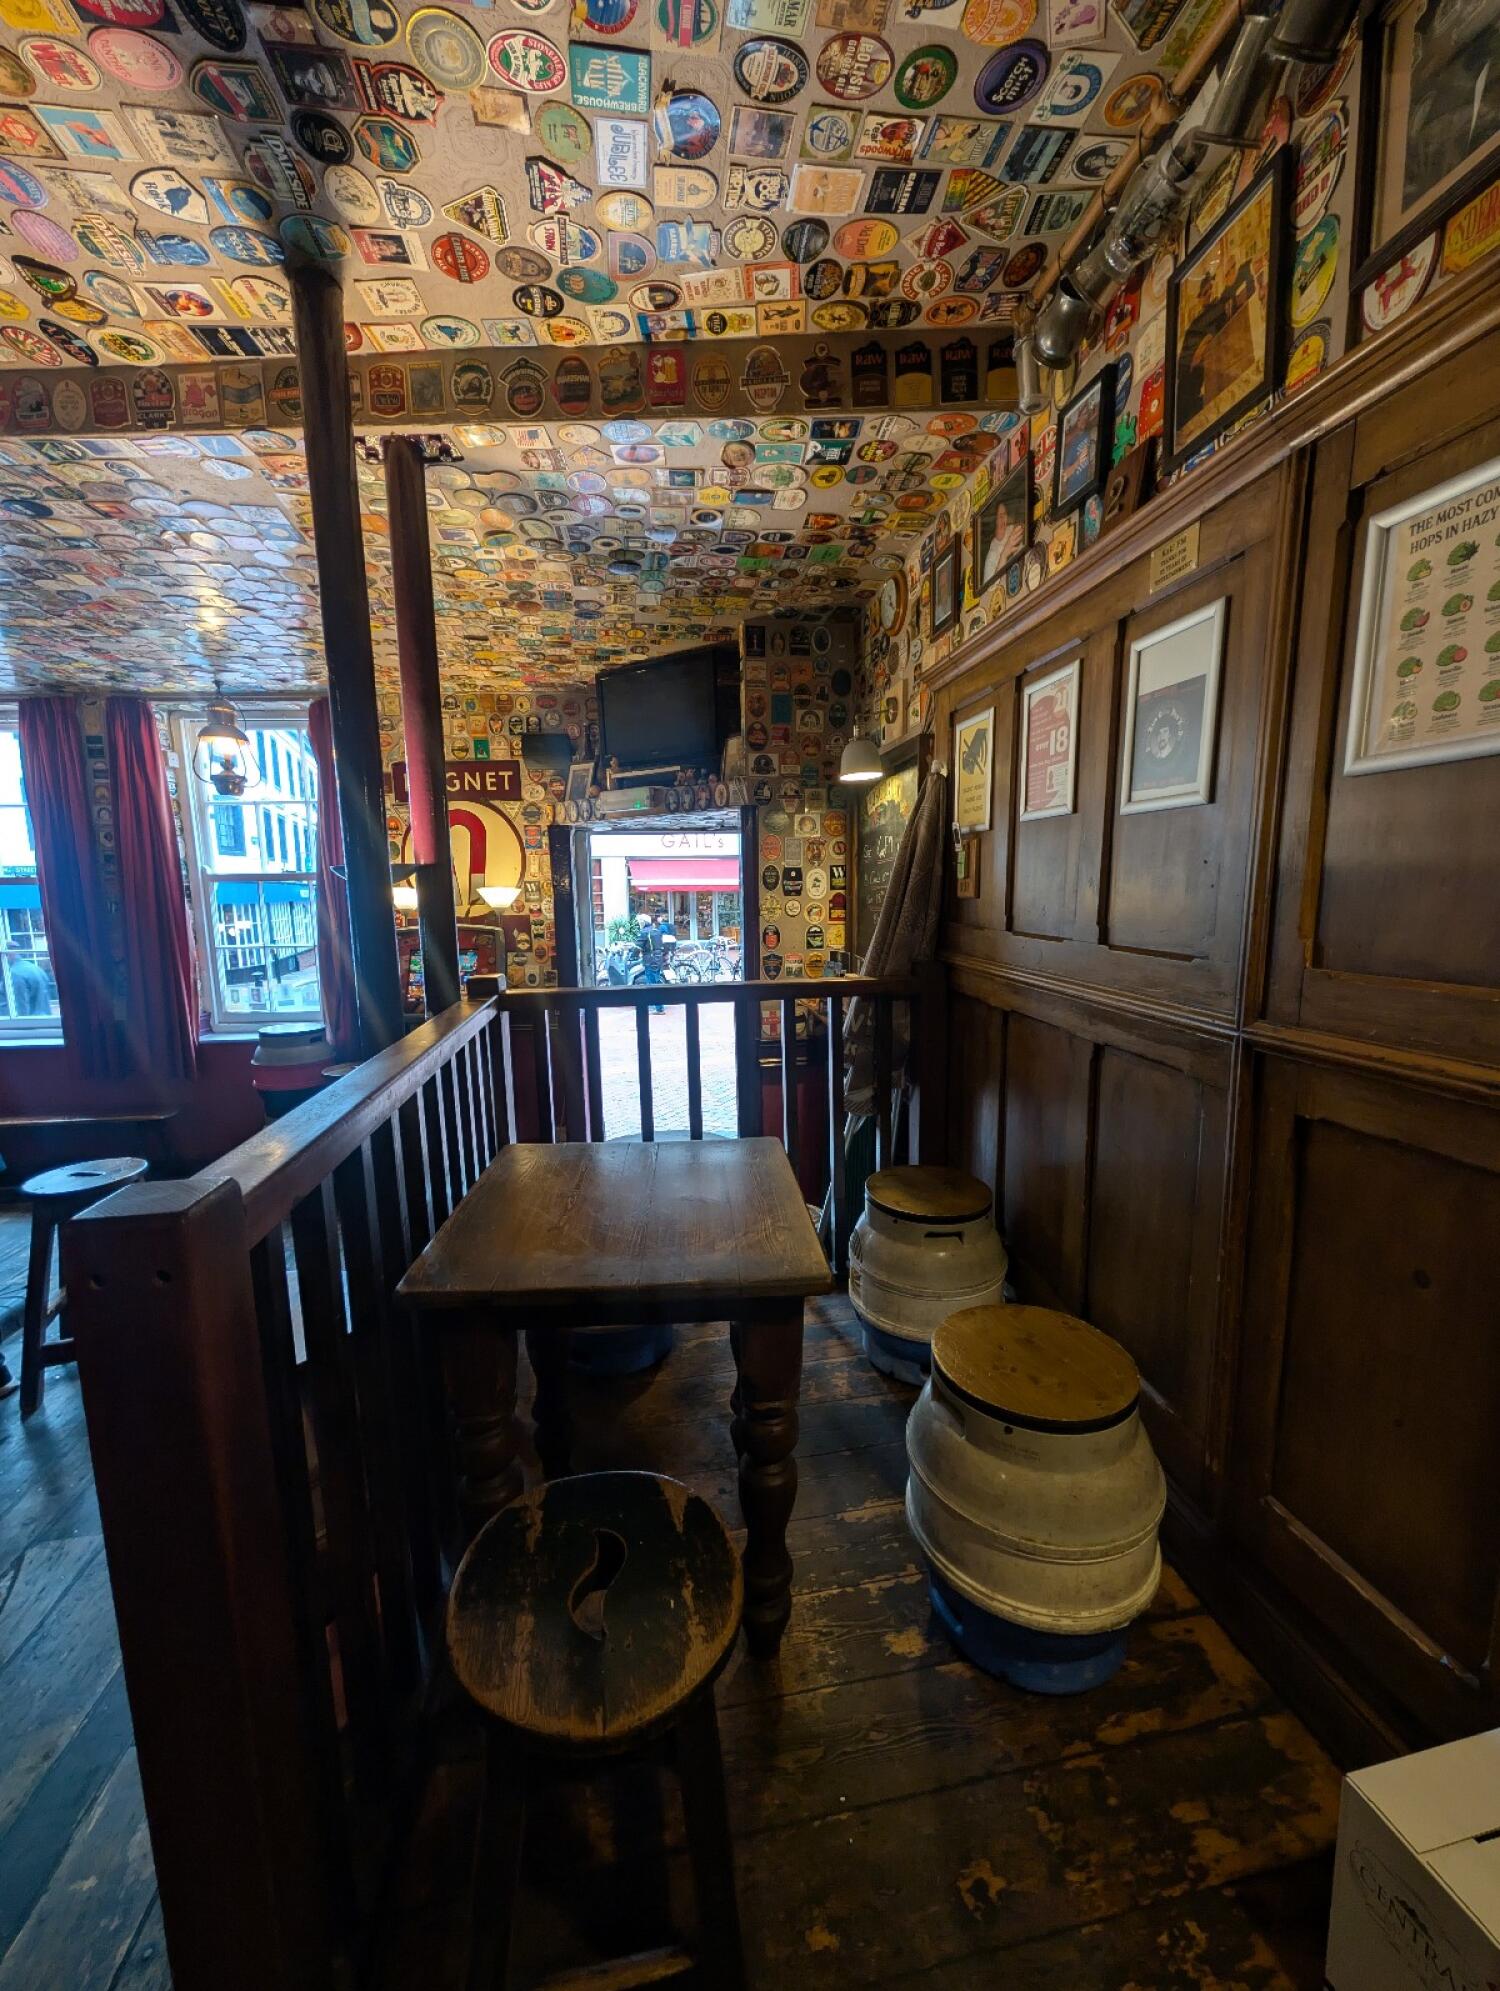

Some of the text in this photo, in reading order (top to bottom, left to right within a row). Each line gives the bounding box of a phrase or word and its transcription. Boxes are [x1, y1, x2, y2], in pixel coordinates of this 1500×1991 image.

[574, 94, 648, 112] BREWHOUSE.
[638, 62, 648, 113] BACKYARD
[261, 134, 312, 211] DALESIDE
[610, 124, 630, 183] JUBILEE
[860, 144, 912, 162] Birkwoods
[93, 214, 145, 277] DALESIDE
[1410, 517, 1433, 537] THE
[1436, 500, 1475, 525] MOST
[1410, 506, 1500, 554] HOPS IN HAZY
[1050, 725, 1069, 756] 18
